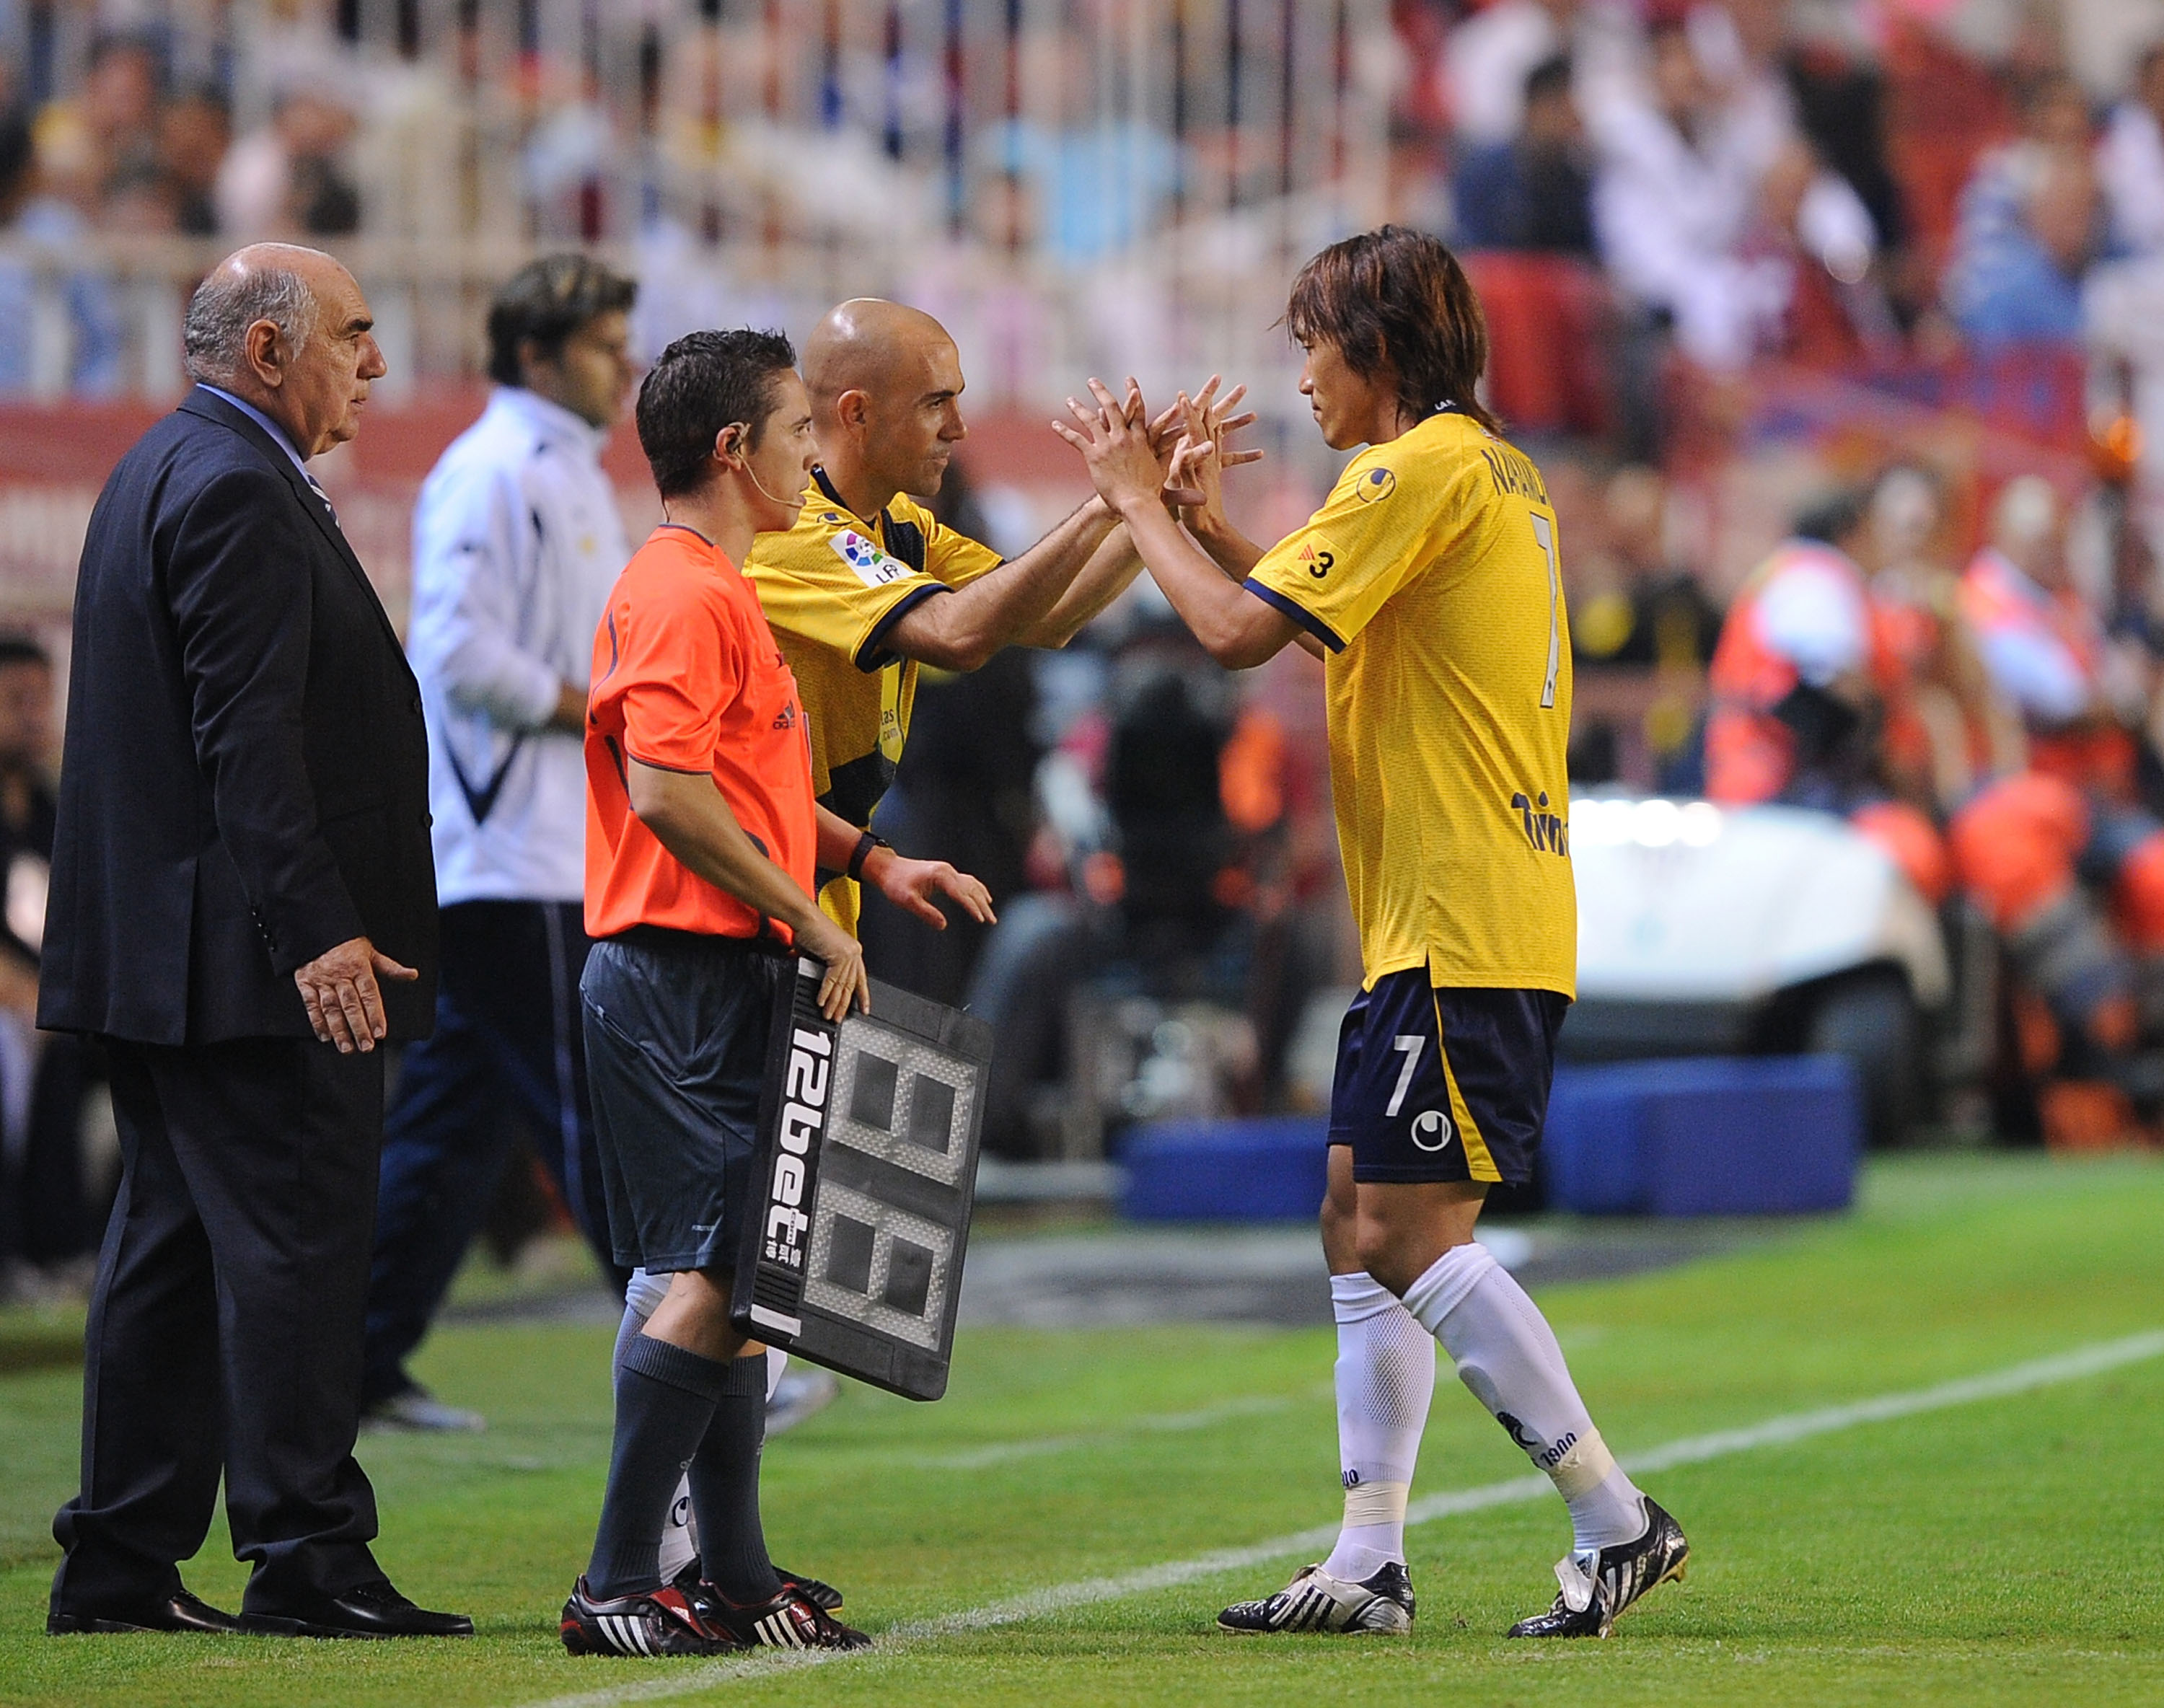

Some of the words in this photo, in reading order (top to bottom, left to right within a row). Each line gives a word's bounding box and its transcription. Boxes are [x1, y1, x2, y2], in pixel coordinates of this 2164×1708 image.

[1529, 511, 1560, 709] 7
[767, 1027, 831, 1246] 12bet
[1385, 1035, 1426, 1117] 7
[1539, 1432, 1578, 1466] 1900
